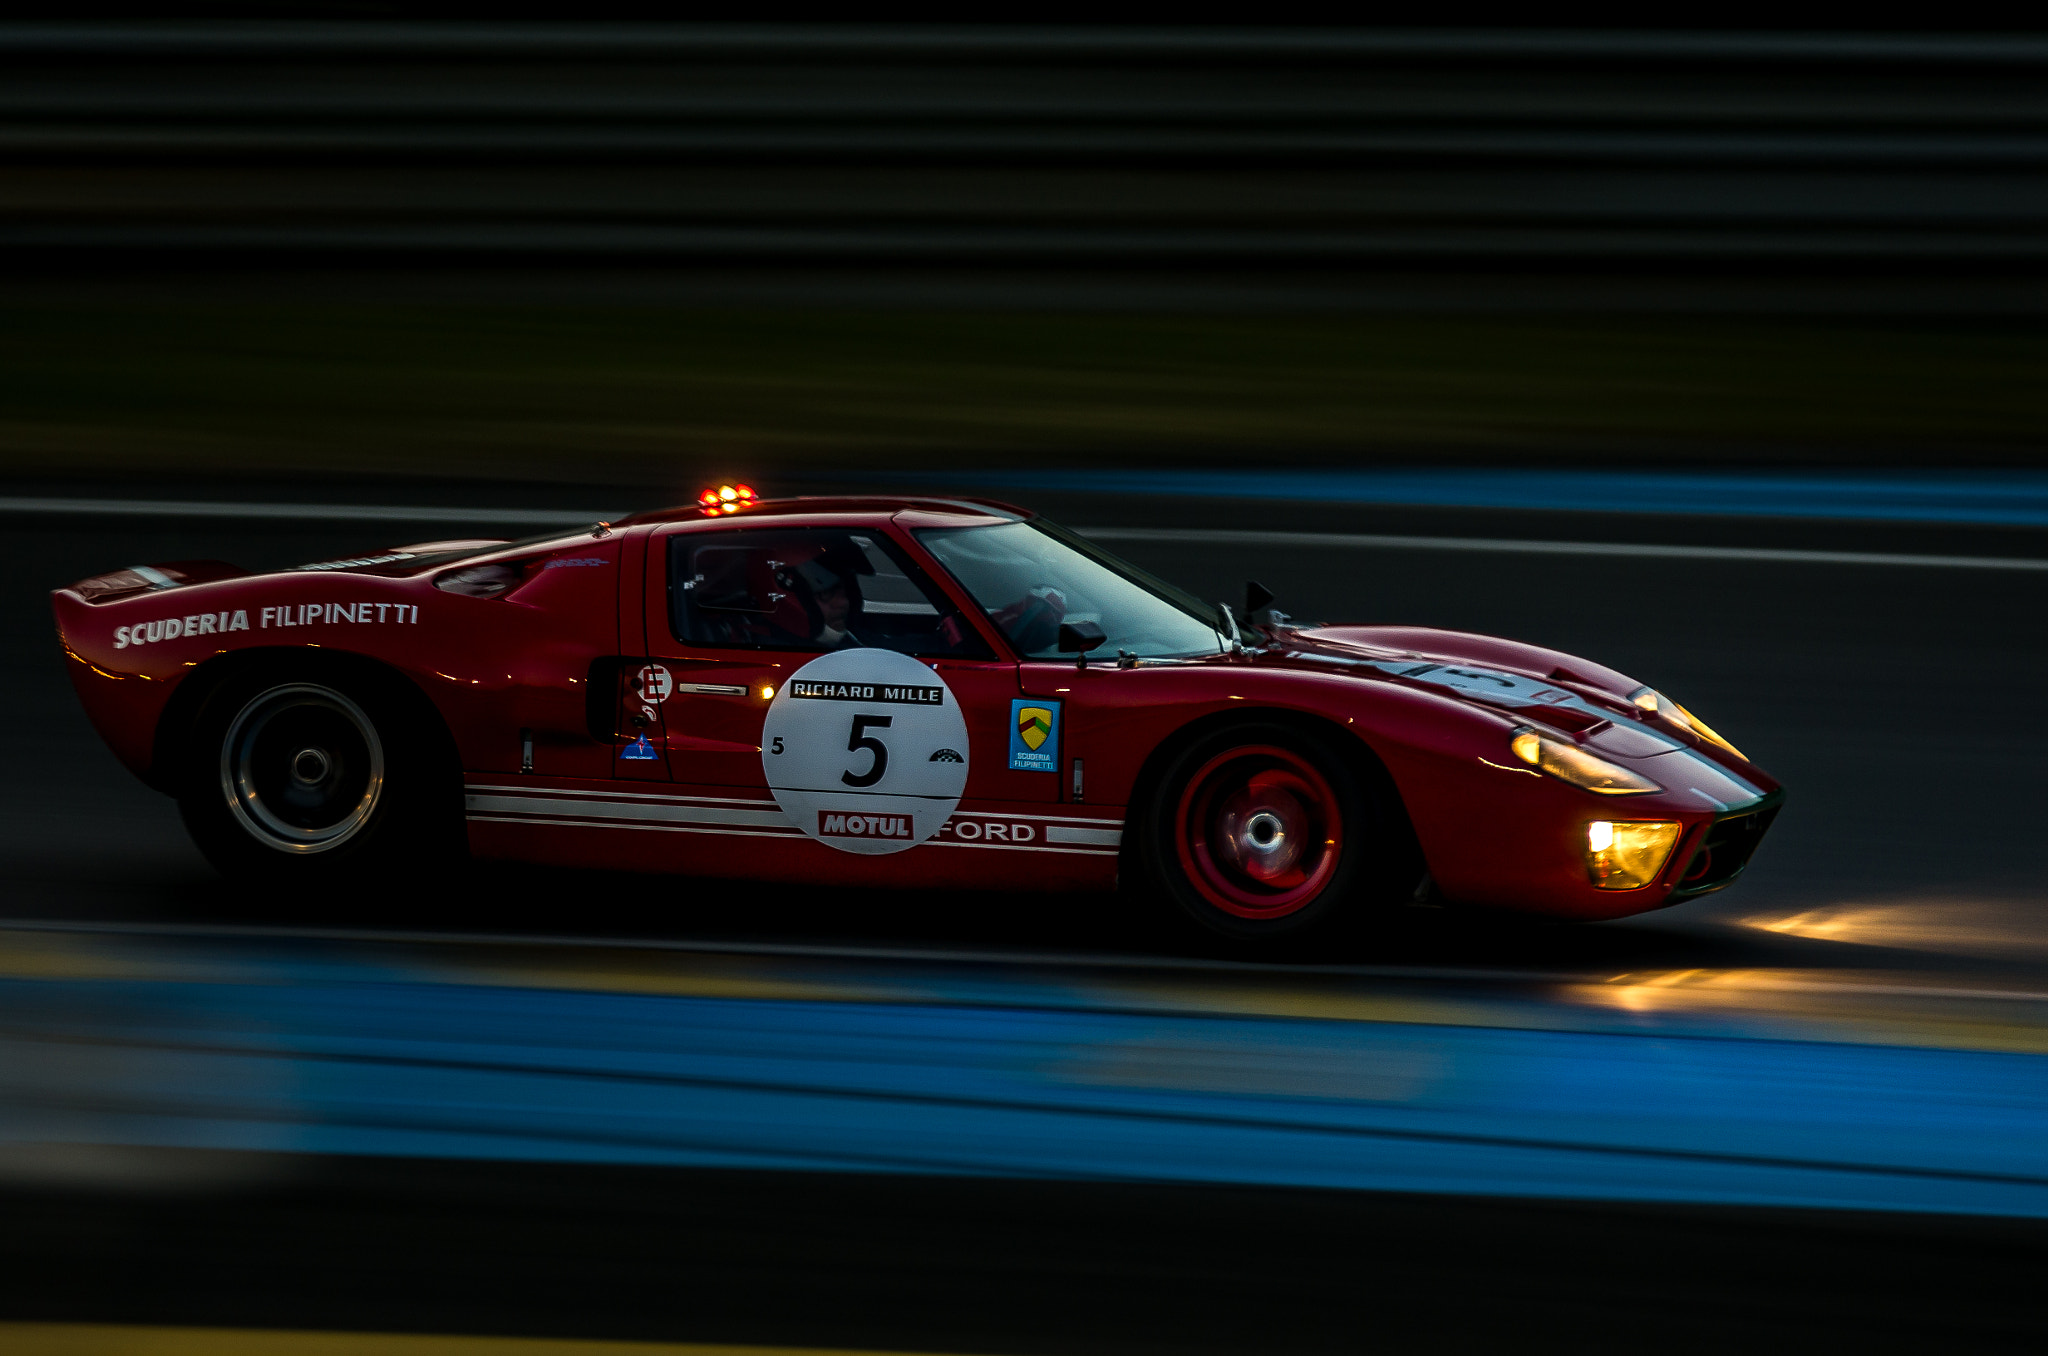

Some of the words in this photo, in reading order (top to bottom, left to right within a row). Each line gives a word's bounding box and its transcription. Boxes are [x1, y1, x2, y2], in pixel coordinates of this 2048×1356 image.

[112, 609, 250, 649] SCUDERIA
[260, 602, 419, 628] FILIPINETTI
[794, 683, 875, 699] RICHARD
[884, 687, 940, 702] MILLE
[771, 737, 785, 755] 5
[841, 714, 893, 788] 5
[1014, 760, 1053, 770] FILIPINETTI
[1017, 752, 1051, 761] SCUDERIA
[823, 814, 909, 836] MOTUL
